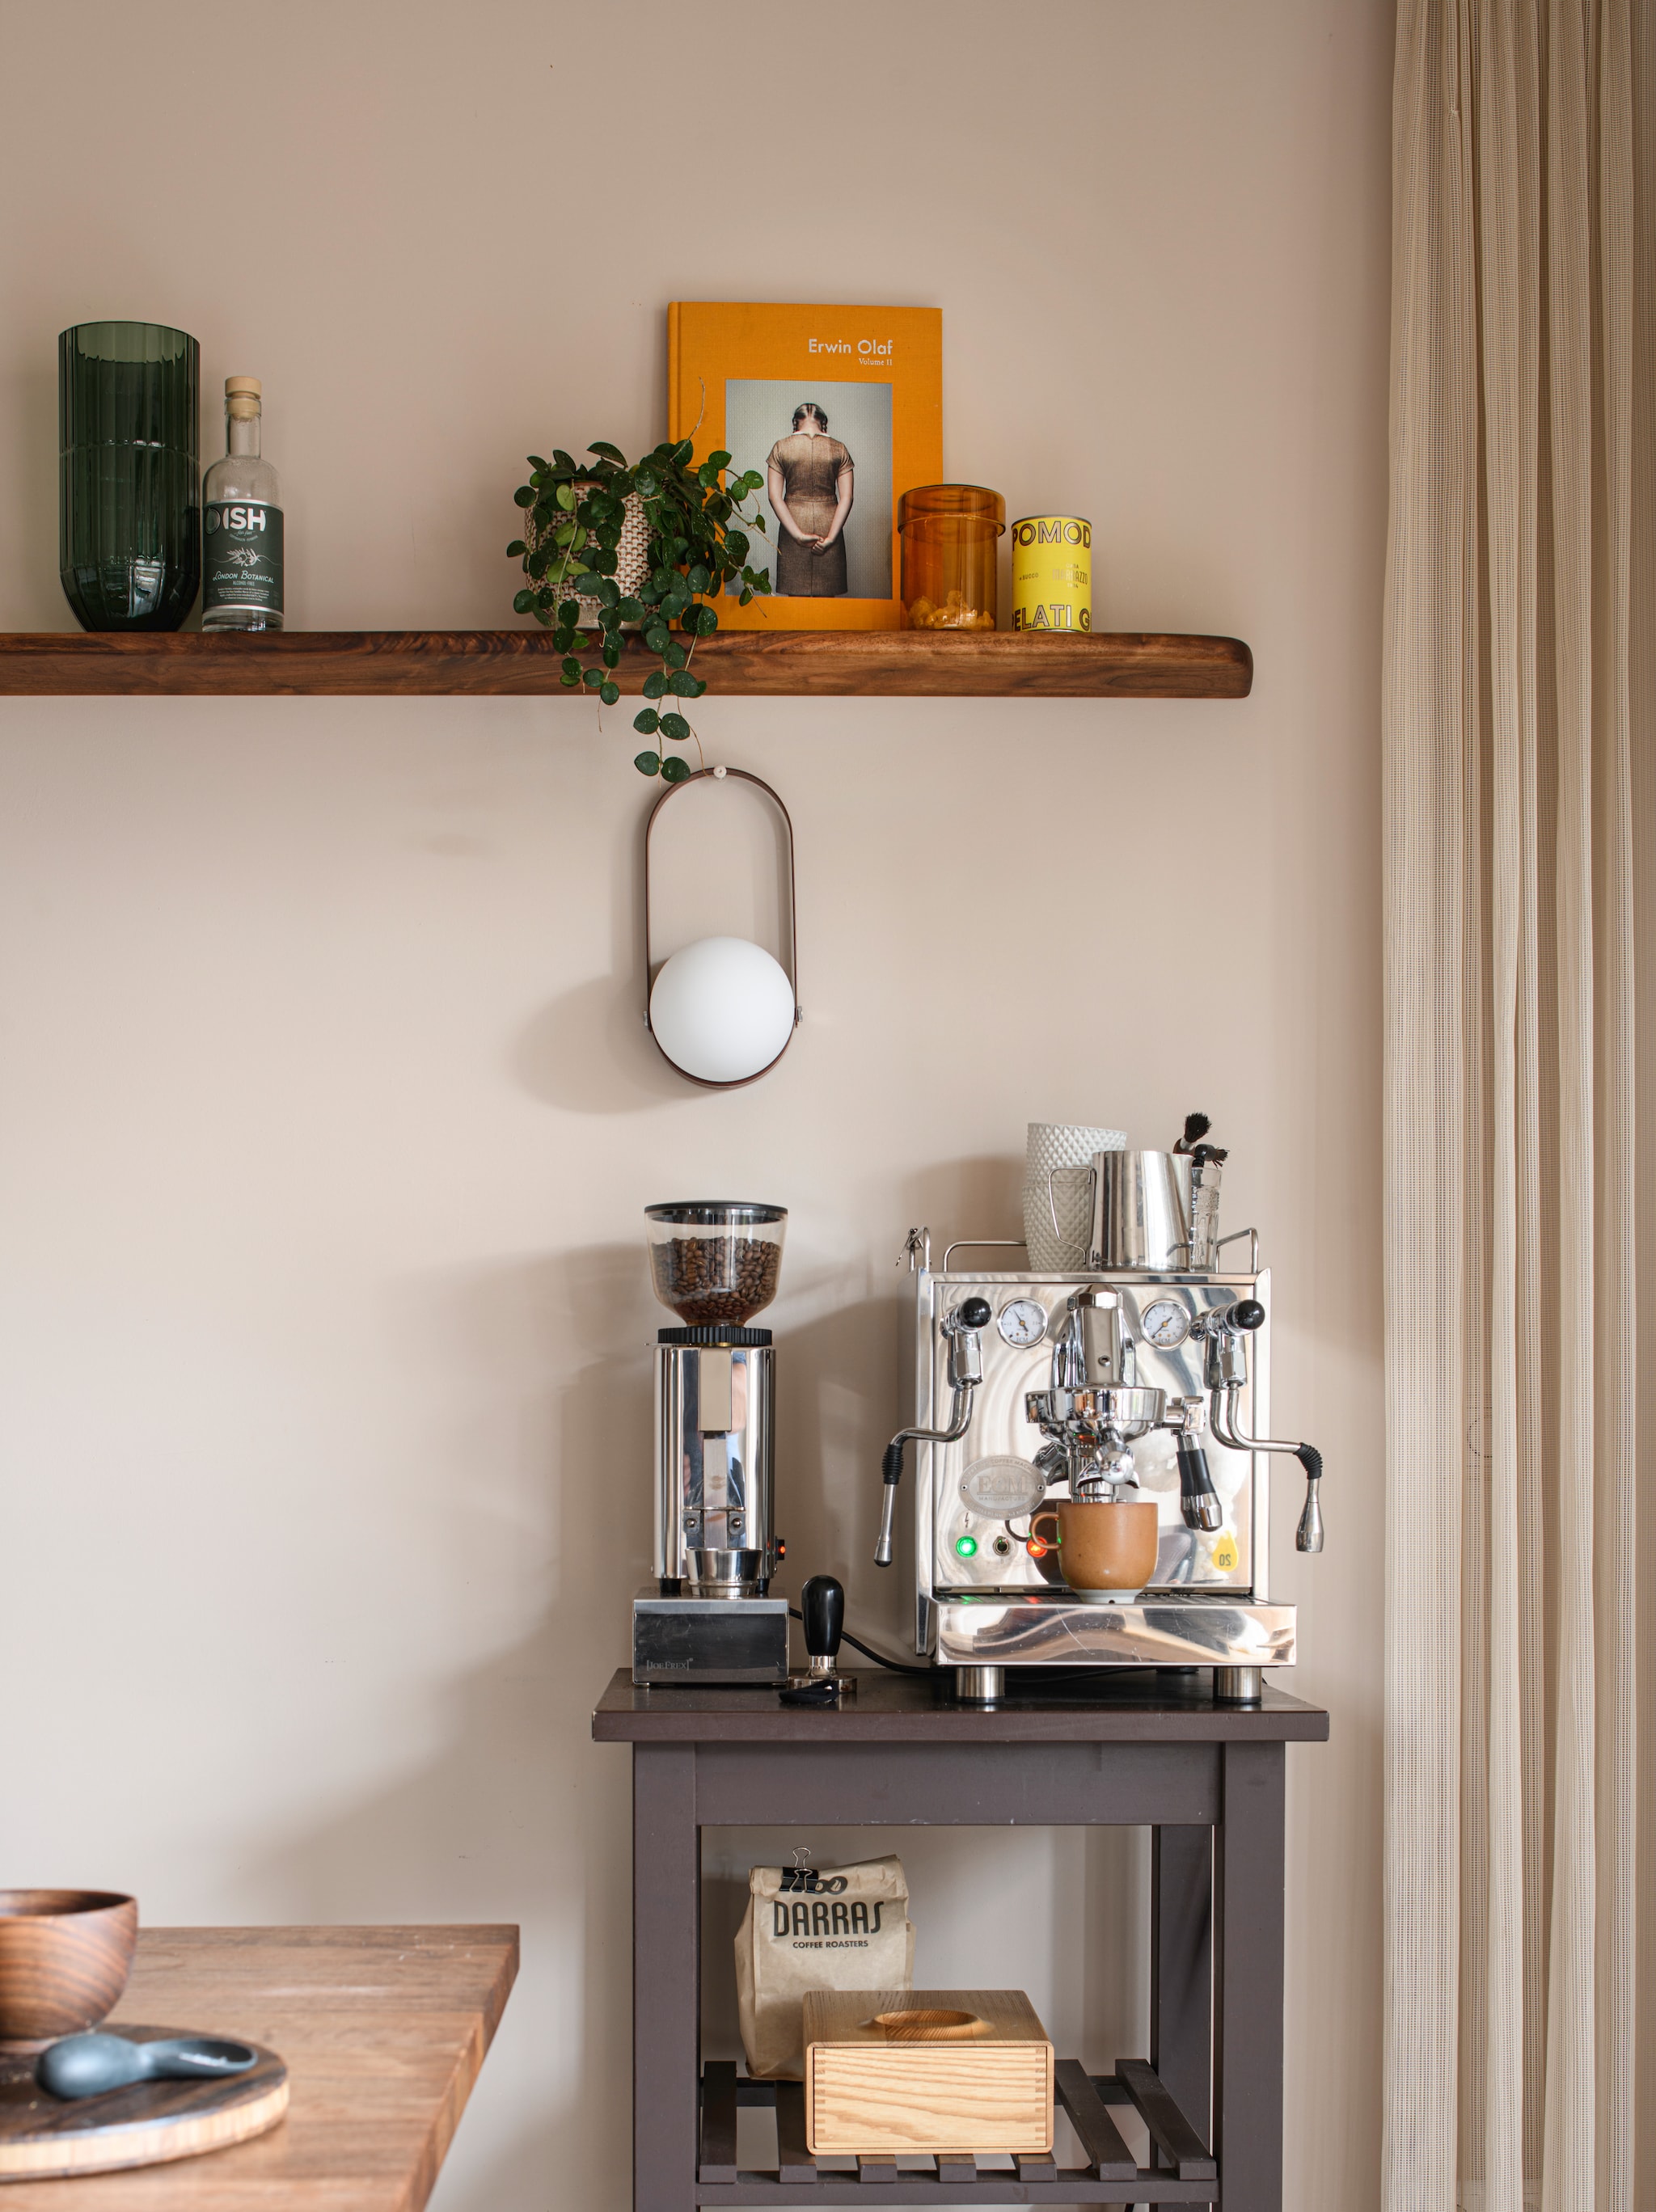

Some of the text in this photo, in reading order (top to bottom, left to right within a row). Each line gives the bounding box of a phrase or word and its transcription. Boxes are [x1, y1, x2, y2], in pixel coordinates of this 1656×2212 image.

[809, 338, 893, 355] Erwin Olaf
[213, 570, 274, 584] LONDON BOTANICAL
[1012, 605, 1072, 631] ELATI
[773, 1901, 884, 1936] DARRAS
